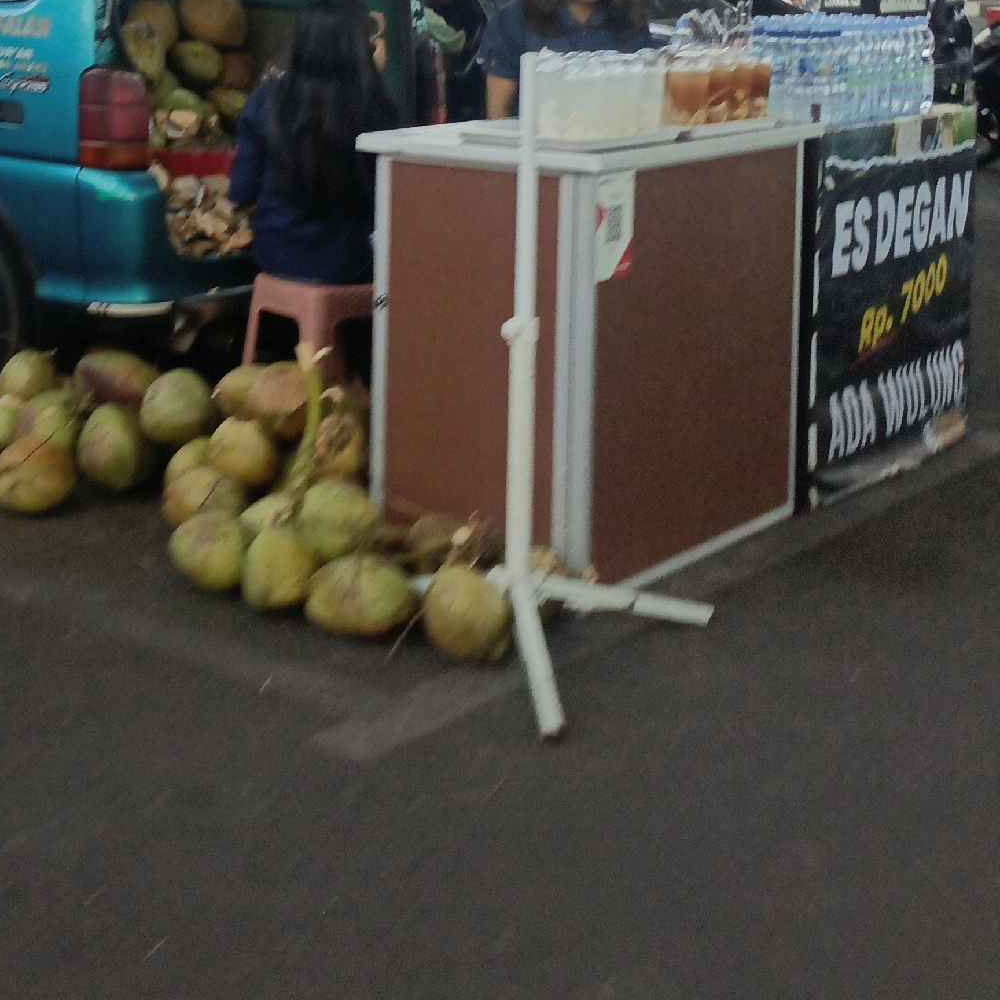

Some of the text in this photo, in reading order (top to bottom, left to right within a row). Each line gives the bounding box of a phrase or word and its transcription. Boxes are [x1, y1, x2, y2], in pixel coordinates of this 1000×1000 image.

[831, 169, 973, 279] ES DEGAN
[900, 252, 948, 325] 7000
[828, 379, 877, 465] ADA
